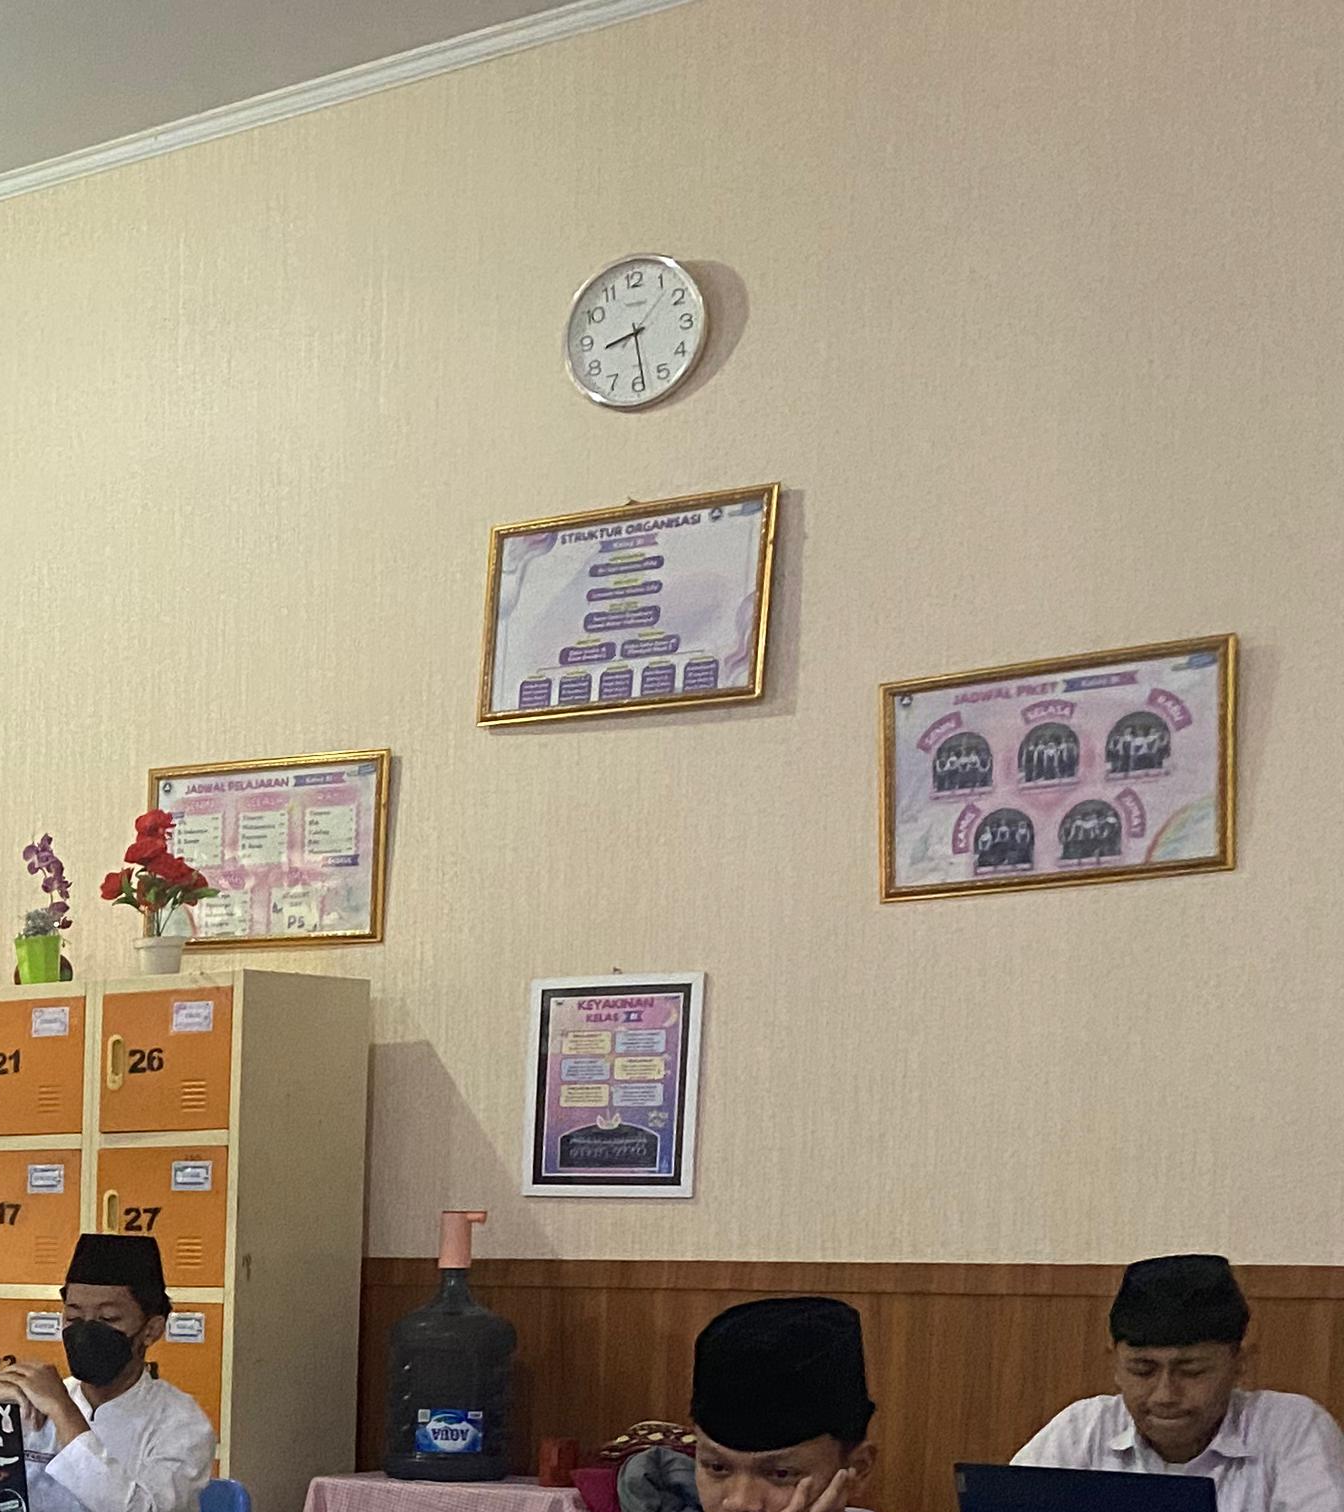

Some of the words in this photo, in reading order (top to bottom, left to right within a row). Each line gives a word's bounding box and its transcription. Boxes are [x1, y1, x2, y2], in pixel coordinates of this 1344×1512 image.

[624, 271, 643, 289] 12
[658, 273, 664, 289] 1
[602, 284, 616, 302] 11
[672, 288, 686, 306] 2
[586, 306, 605, 325] 10
[679, 313, 693, 330] 3
[580, 335, 594, 352] 9
[674, 341, 686, 357] 4
[588, 359, 601, 376] 8
[656, 363, 670, 380] 5
[606, 373, 619, 391] 7
[632, 376, 646, 393] 6
[561, 527, 623, 545] STRUKTUR
[625, 513, 702, 535] ORGANISASI
[954, 686, 1011, 706] JADWAL
[1016, 682, 1059, 698] PIKET
[185, 784, 226, 796] JADWAL
[227, 777, 289, 793] PELAJARAN
[577, 998, 654, 1011] KEYAKINAN
[586, 1012, 620, 1023] KELAS
[128, 1048, 164, 1074] 26
[123, 1207, 162, 1232] 27
[431, 1427, 470, 1442] AQUA
